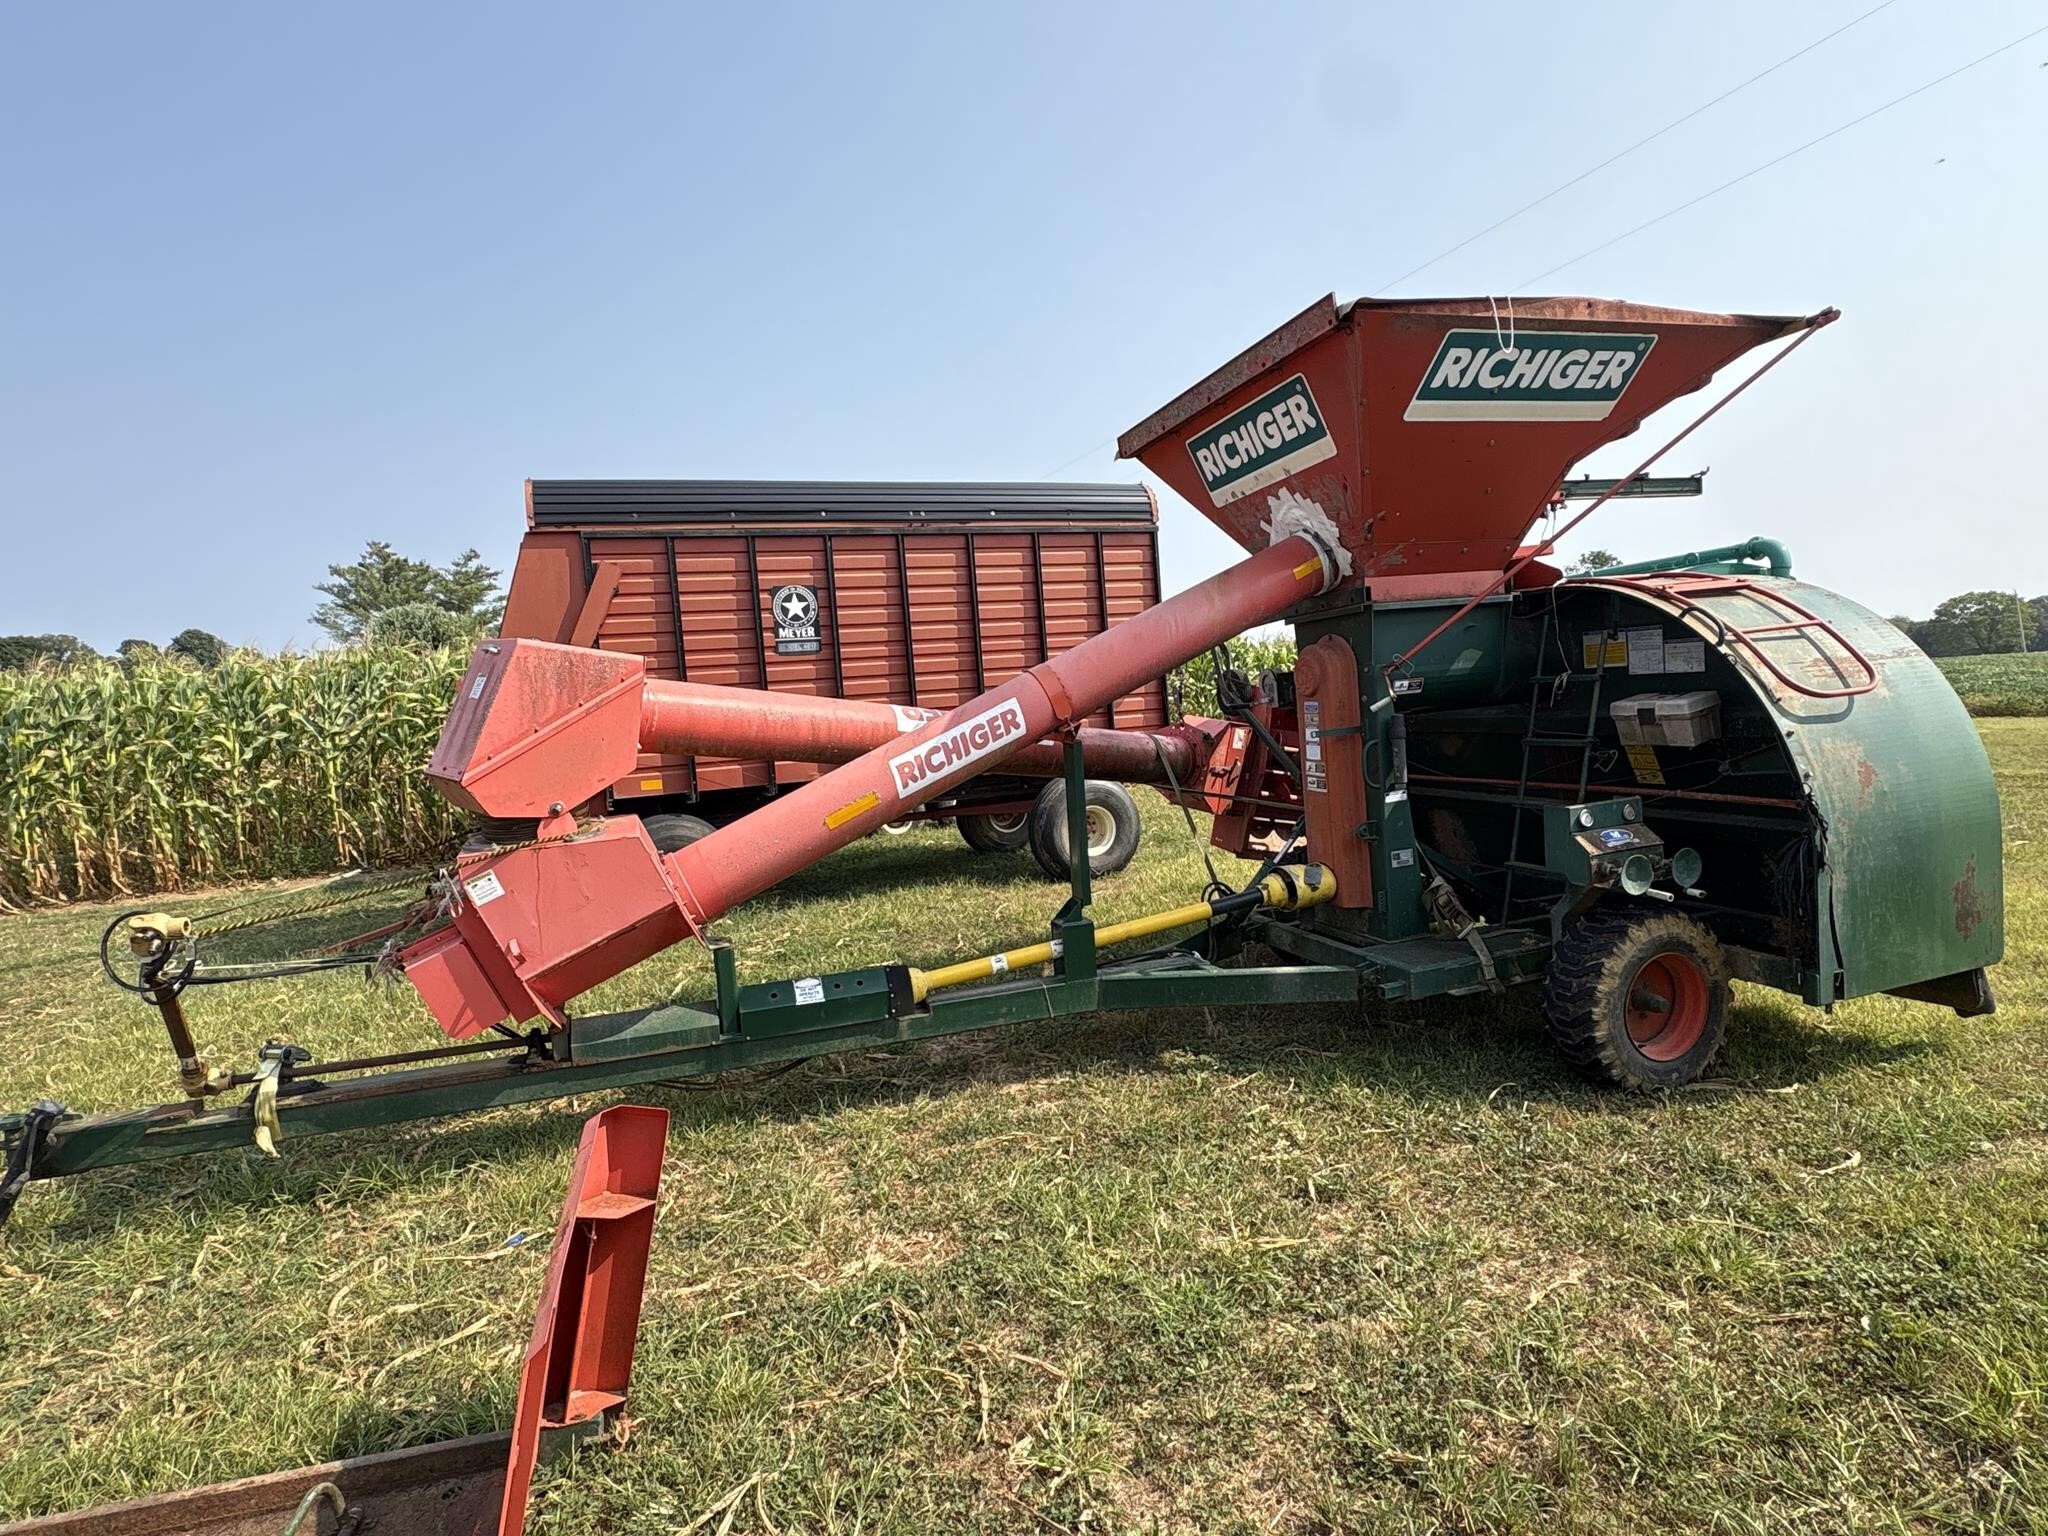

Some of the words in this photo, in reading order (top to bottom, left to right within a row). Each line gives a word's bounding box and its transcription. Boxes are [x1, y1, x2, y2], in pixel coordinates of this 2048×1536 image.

[1429, 347, 1637, 390] RICHIGER
[1195, 393, 1317, 482] RICHIGER
[778, 627, 815, 638] MEYER
[895, 708, 1021, 790] RICHIGER
